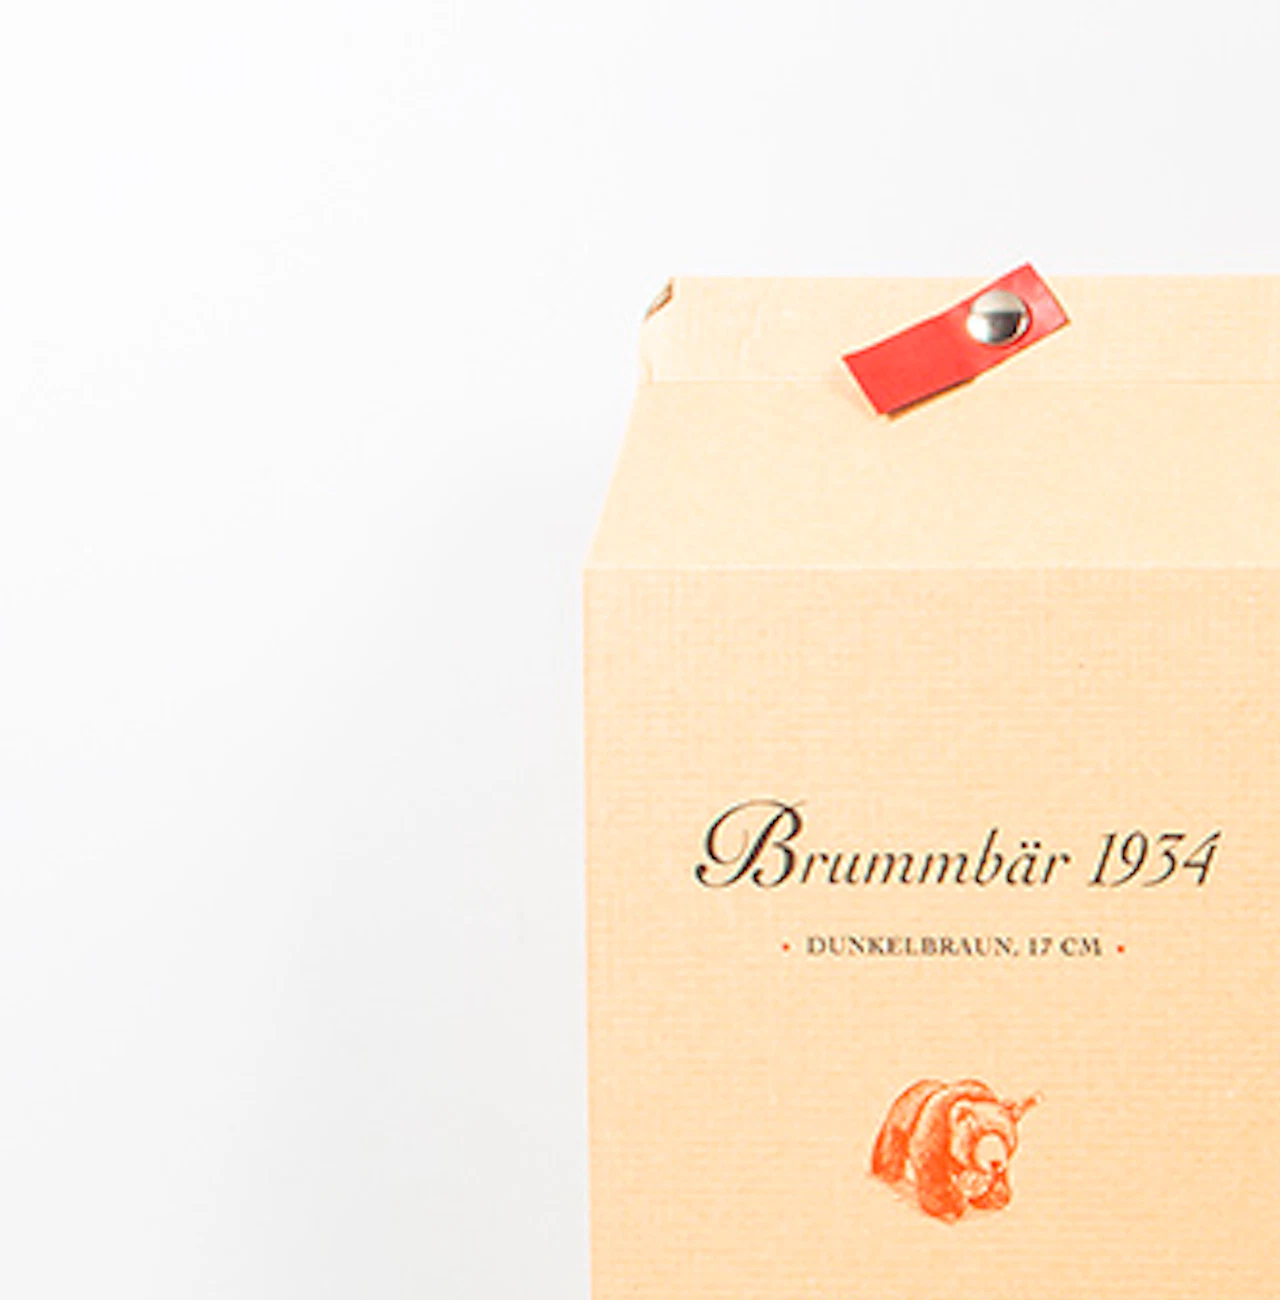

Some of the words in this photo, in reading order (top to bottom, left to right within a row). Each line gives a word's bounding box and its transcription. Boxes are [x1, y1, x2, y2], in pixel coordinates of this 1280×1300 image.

[694, 799, 1072, 888] Brummbär
[1087, 830, 1223, 888] 1934
[806, 936, 1020, 958] DUNKELBRAUN,
[1028, 937, 1053, 957] 17
[1060, 937, 1103, 957] CM
